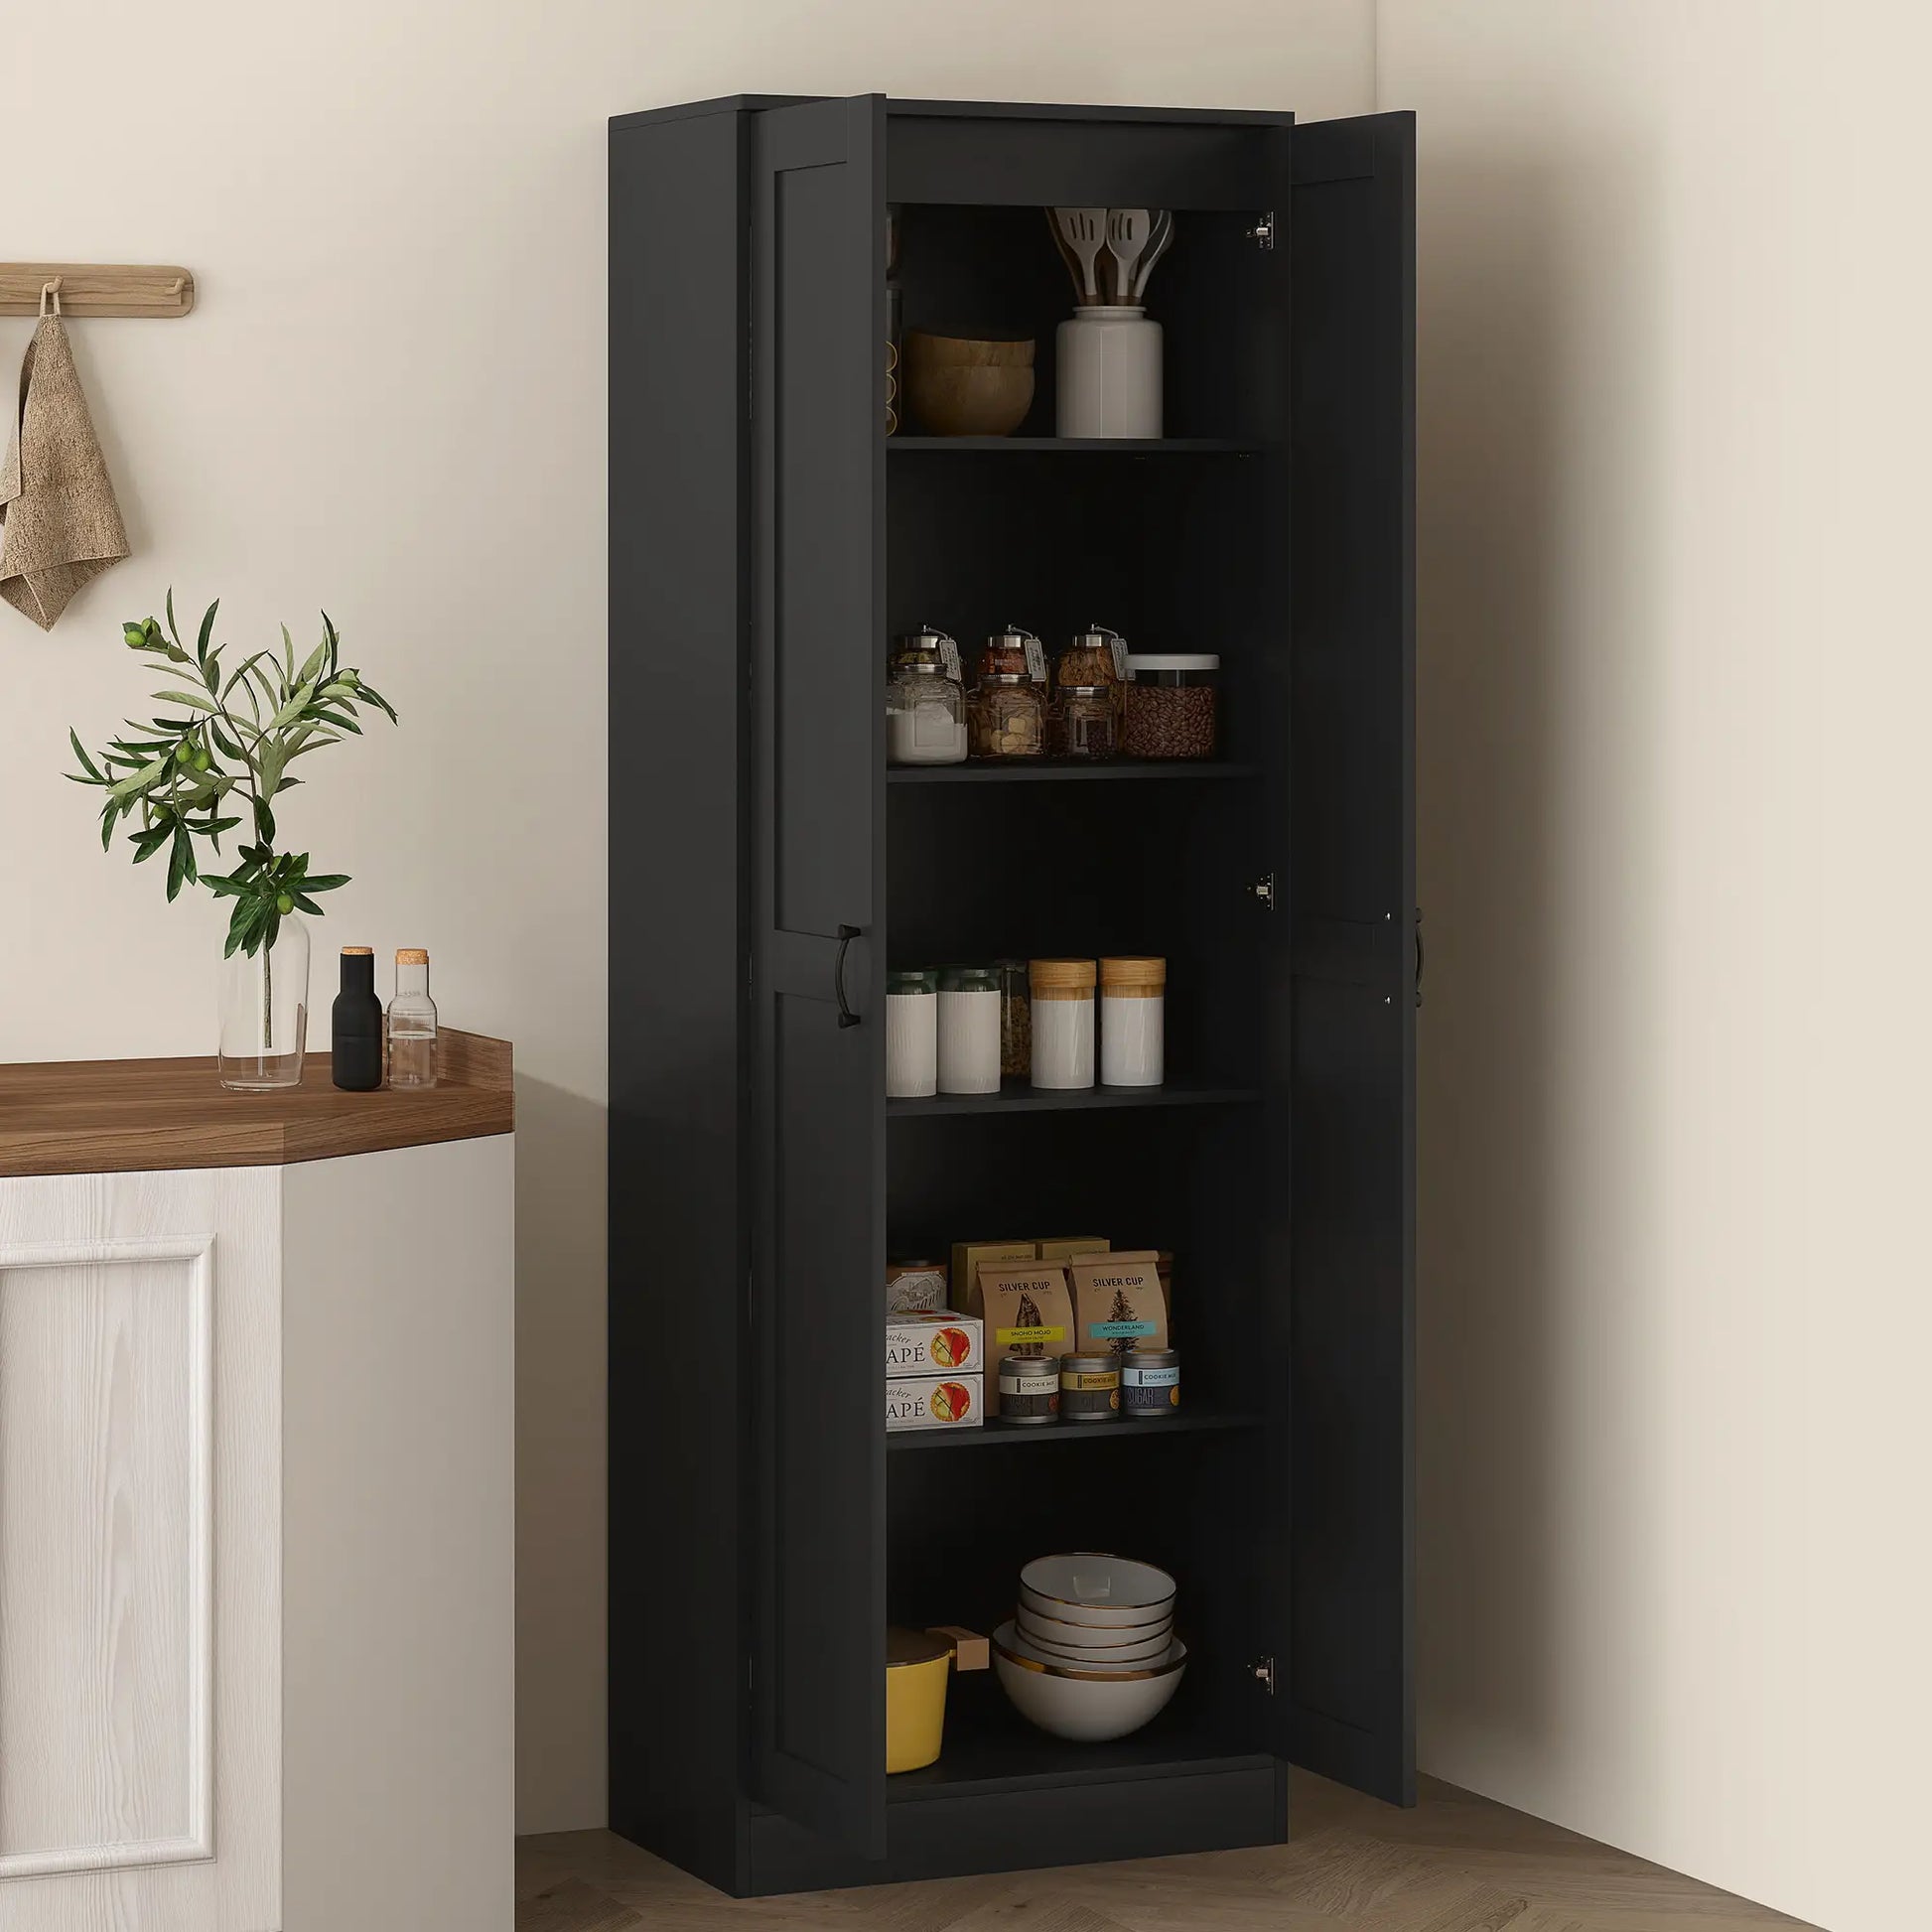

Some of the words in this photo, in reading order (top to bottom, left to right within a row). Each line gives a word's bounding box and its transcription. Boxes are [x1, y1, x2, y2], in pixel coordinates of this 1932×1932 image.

[999, 1282, 1031, 1292] SILVER
[1032, 1281, 1050, 1291] CUP
[1093, 1278, 1123, 1288] SILVER
[1126, 1277, 1144, 1286] CUP
[886, 1333, 911, 1344] acker
[886, 1388, 911, 1399] acker
[1128, 1388, 1154, 1406] SUGAR
